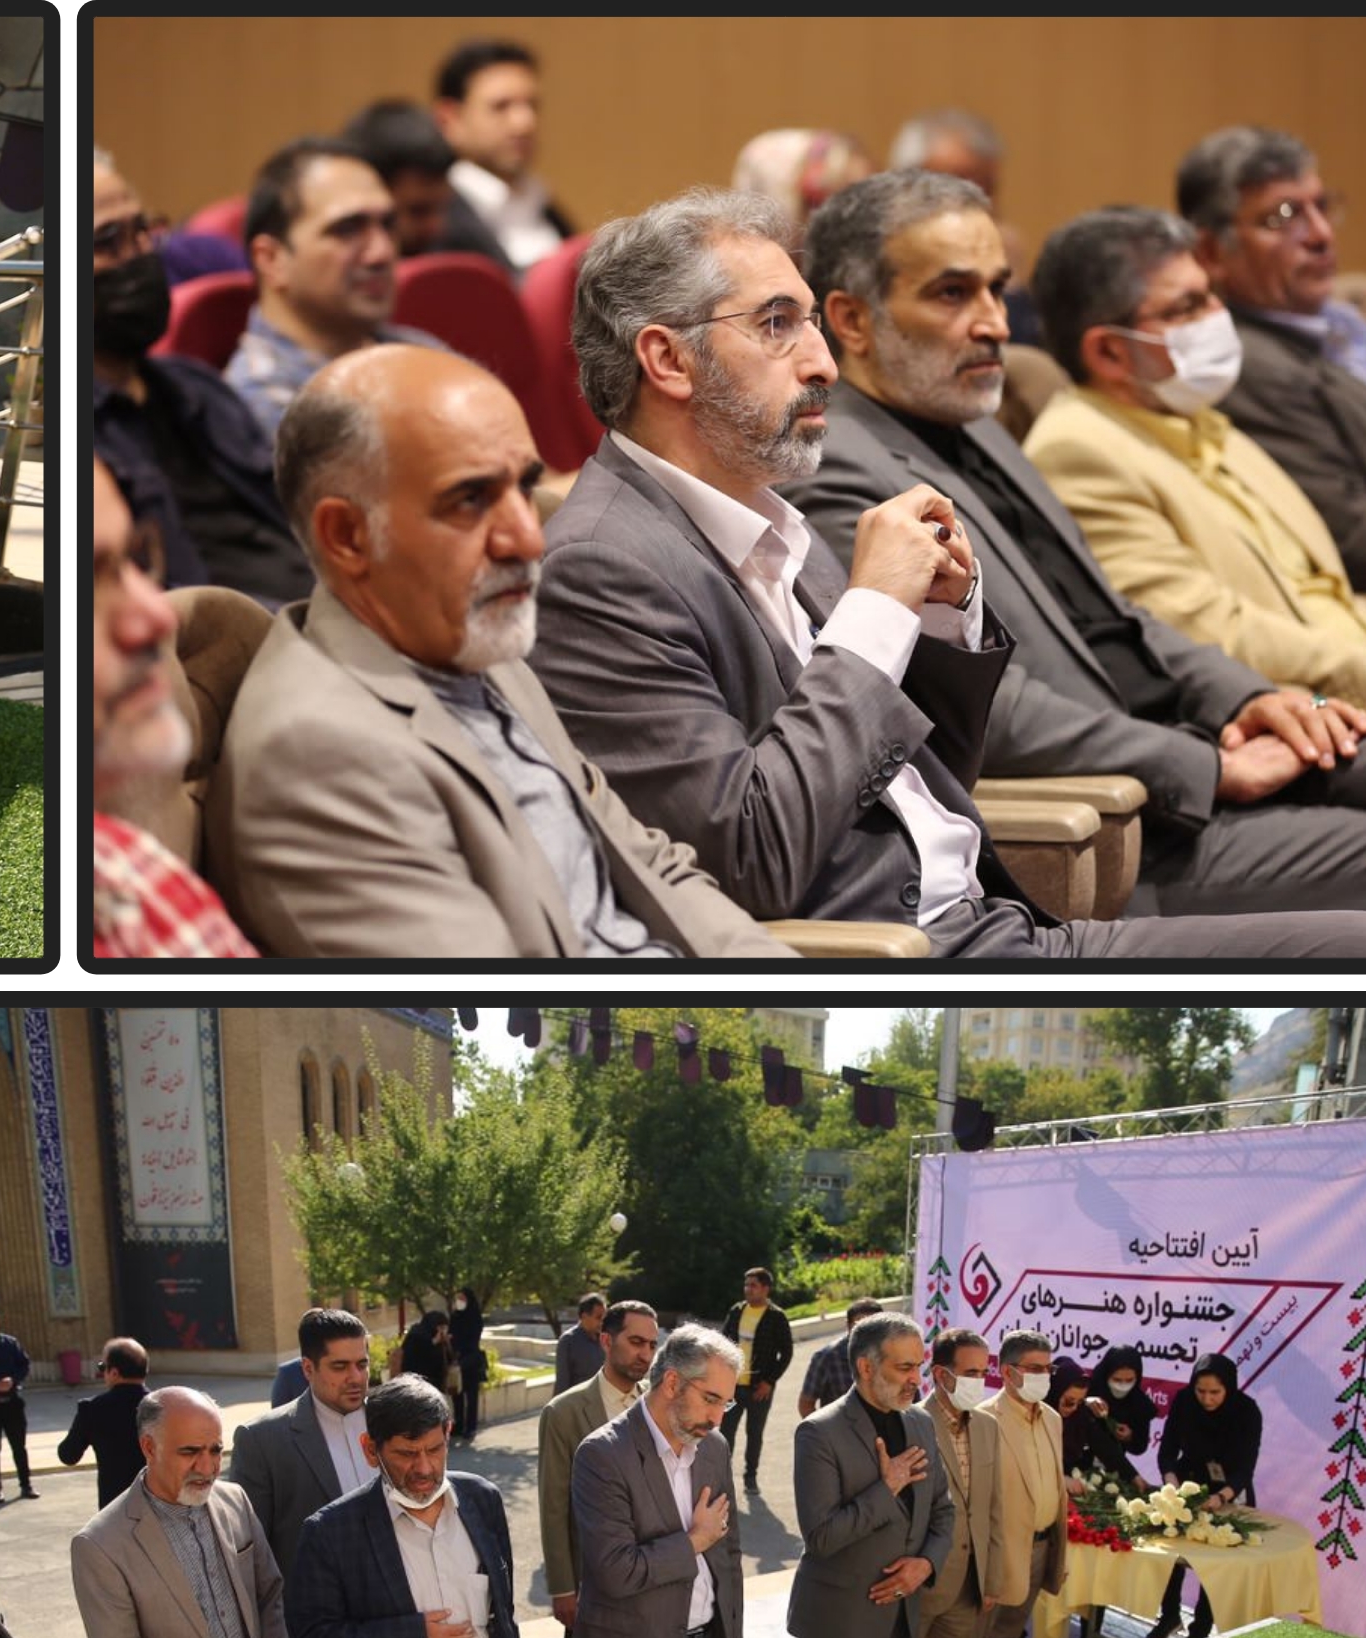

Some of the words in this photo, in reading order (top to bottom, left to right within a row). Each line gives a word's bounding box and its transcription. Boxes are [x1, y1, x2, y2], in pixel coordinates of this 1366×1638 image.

[1129, 1232, 1205, 1264] افتتاحیه
[1211, 1228, 1259, 1267] آیین
[1021, 1283, 1127, 1317] هنرهای
[1133, 1291, 1235, 1331] جشنواره
[1137, 1337, 1199, 1370] تجسم
